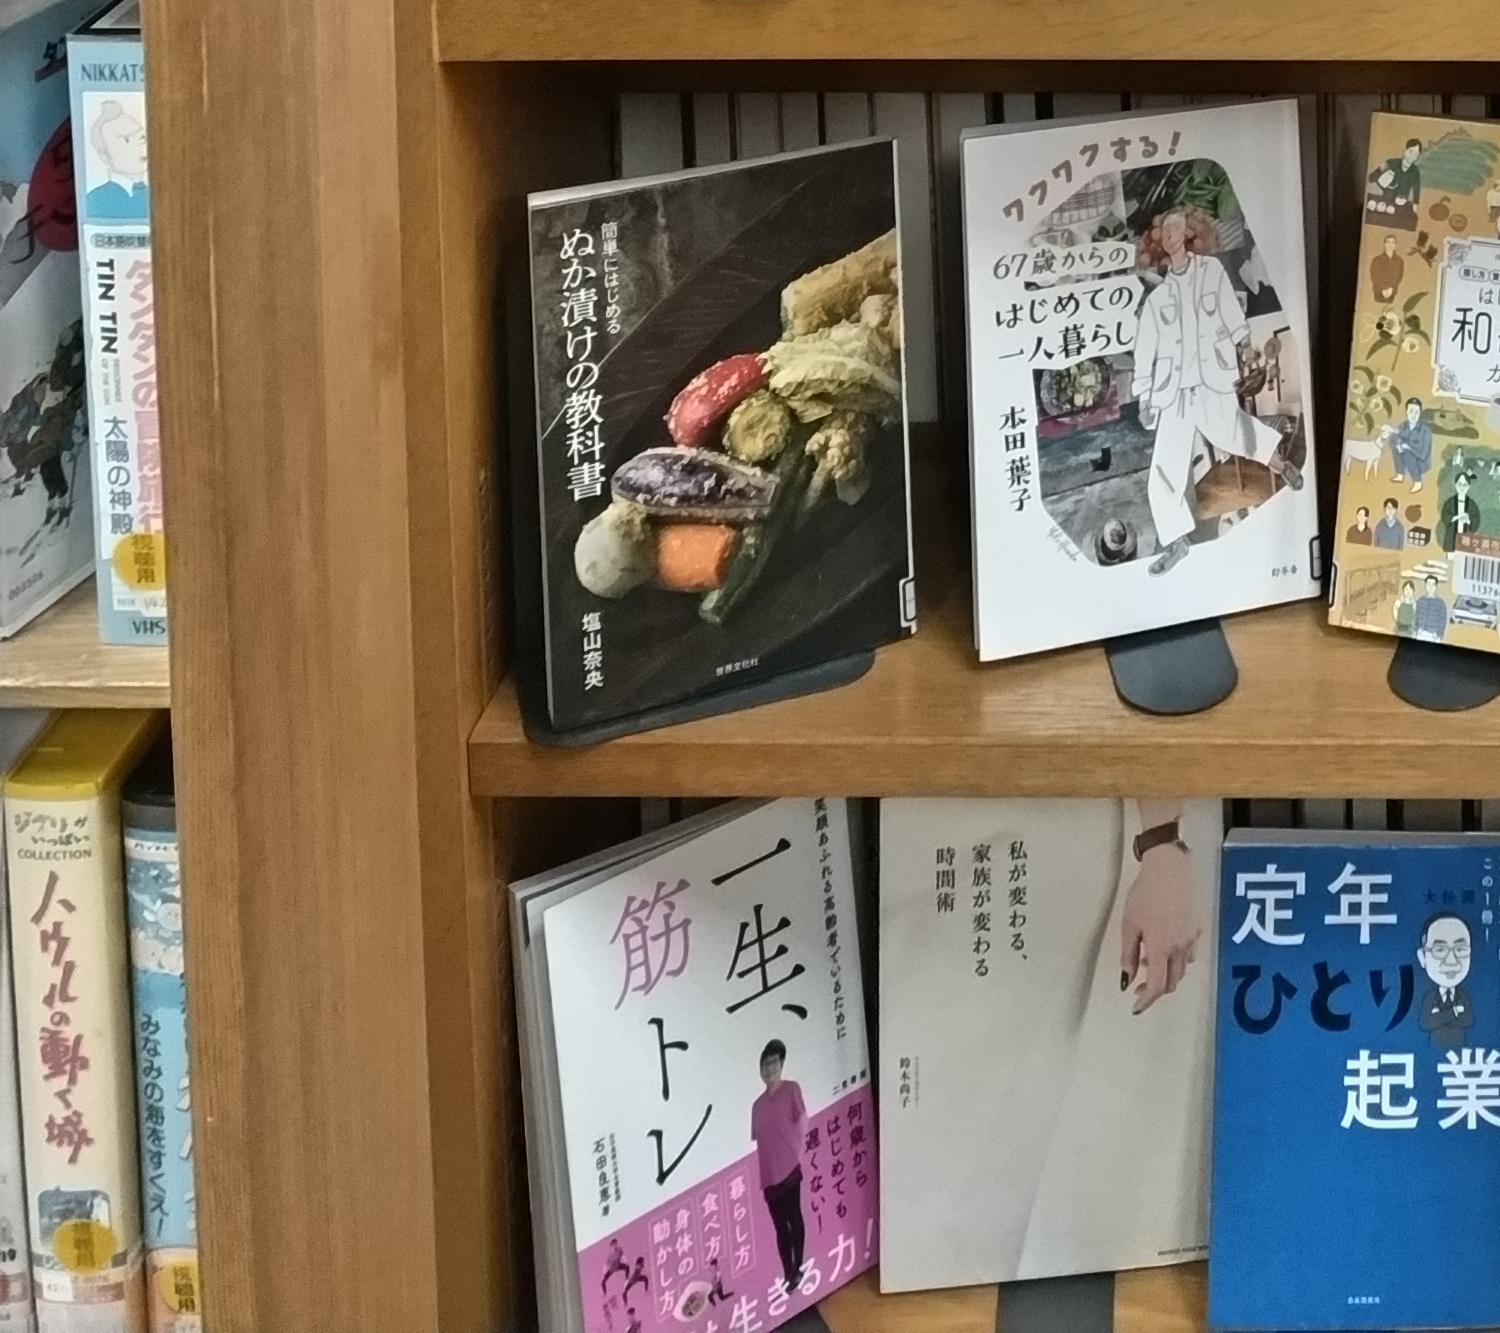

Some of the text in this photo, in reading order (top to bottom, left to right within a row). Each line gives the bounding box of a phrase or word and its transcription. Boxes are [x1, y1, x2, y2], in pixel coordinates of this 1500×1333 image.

[1002, 131, 1182, 223] ワクワクする!
[97, 258, 119, 354] TIN TIN
[601, 220, 622, 335] 簡単にはじめる
[992, 245, 1130, 281] 67歳からの
[994, 282, 1135, 331] はじめての
[559, 227, 606, 503] ぬか漬けの教科書
[997, 320, 1135, 365] 一人暮らし
[103, 414, 134, 536] 太陽の神殿
[17, 848, 93, 862] COLLECTION
[934, 846, 958, 915] 時間術
[1006, 839, 1030, 963] 私が変わる、
[711, 837, 809, 1023] 一生、
[970, 842, 994, 979] 家族が変わる
[1231, 862, 1398, 946] 定年
[29, 869, 95, 1166] ハウルの動く城
[609, 877, 714, 1187] 筋トレ
[1231, 960, 1415, 1036] ひとり
